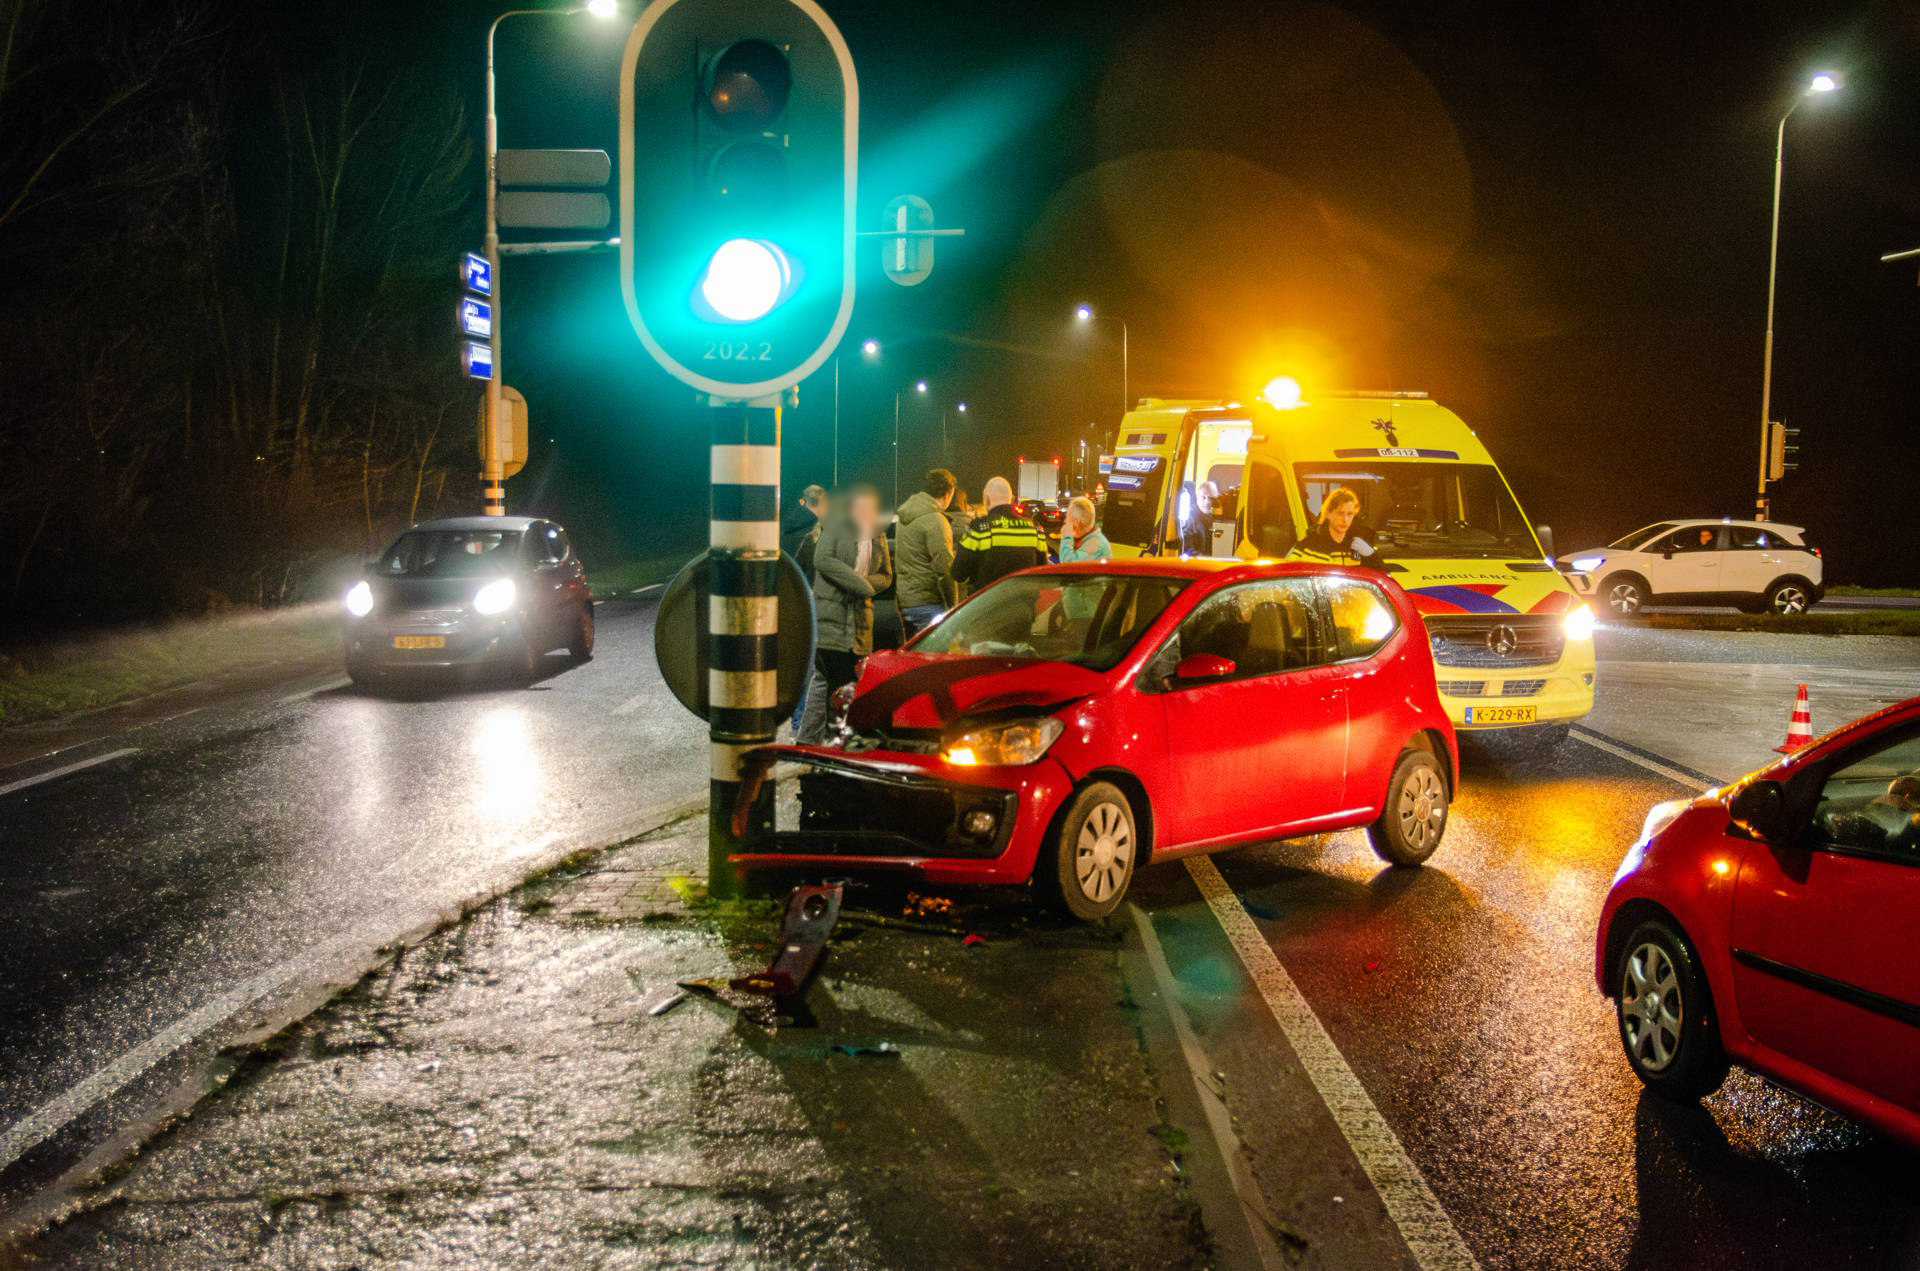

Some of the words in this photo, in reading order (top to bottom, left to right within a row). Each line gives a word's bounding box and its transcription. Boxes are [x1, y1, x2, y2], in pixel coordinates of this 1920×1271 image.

[703, 341, 772, 361] 202.2
[1421, 573, 1520, 581] AMBULANCE
[1476, 709, 1532, 721] K-229-RX
